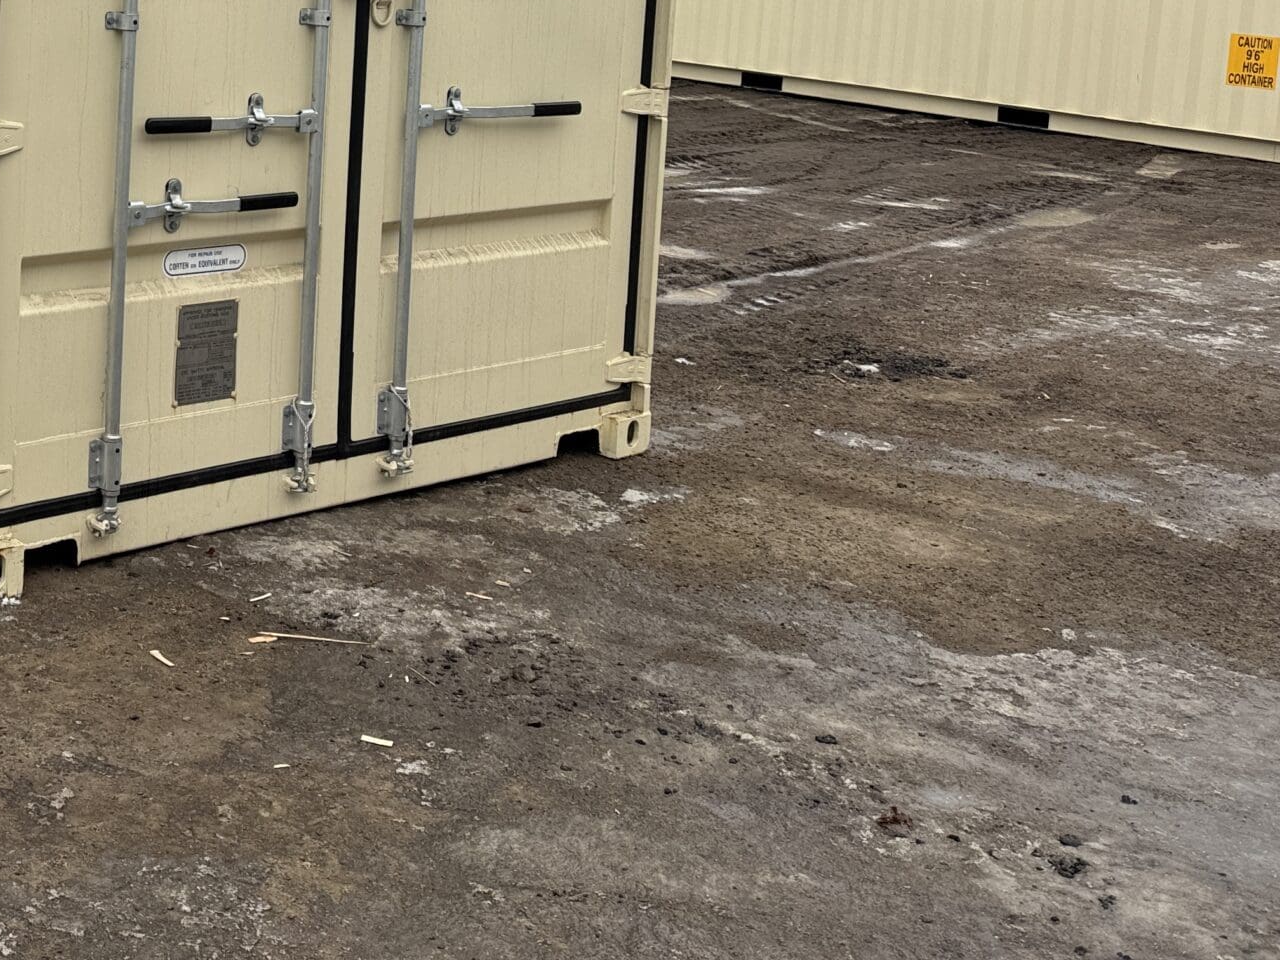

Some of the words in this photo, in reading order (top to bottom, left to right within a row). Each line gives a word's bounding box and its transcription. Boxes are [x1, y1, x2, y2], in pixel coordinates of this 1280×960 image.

[1238, 36, 1273, 50] CAUTION
[1242, 61, 1264, 75] HIGH
[1228, 73, 1274, 89] CONTAINER
